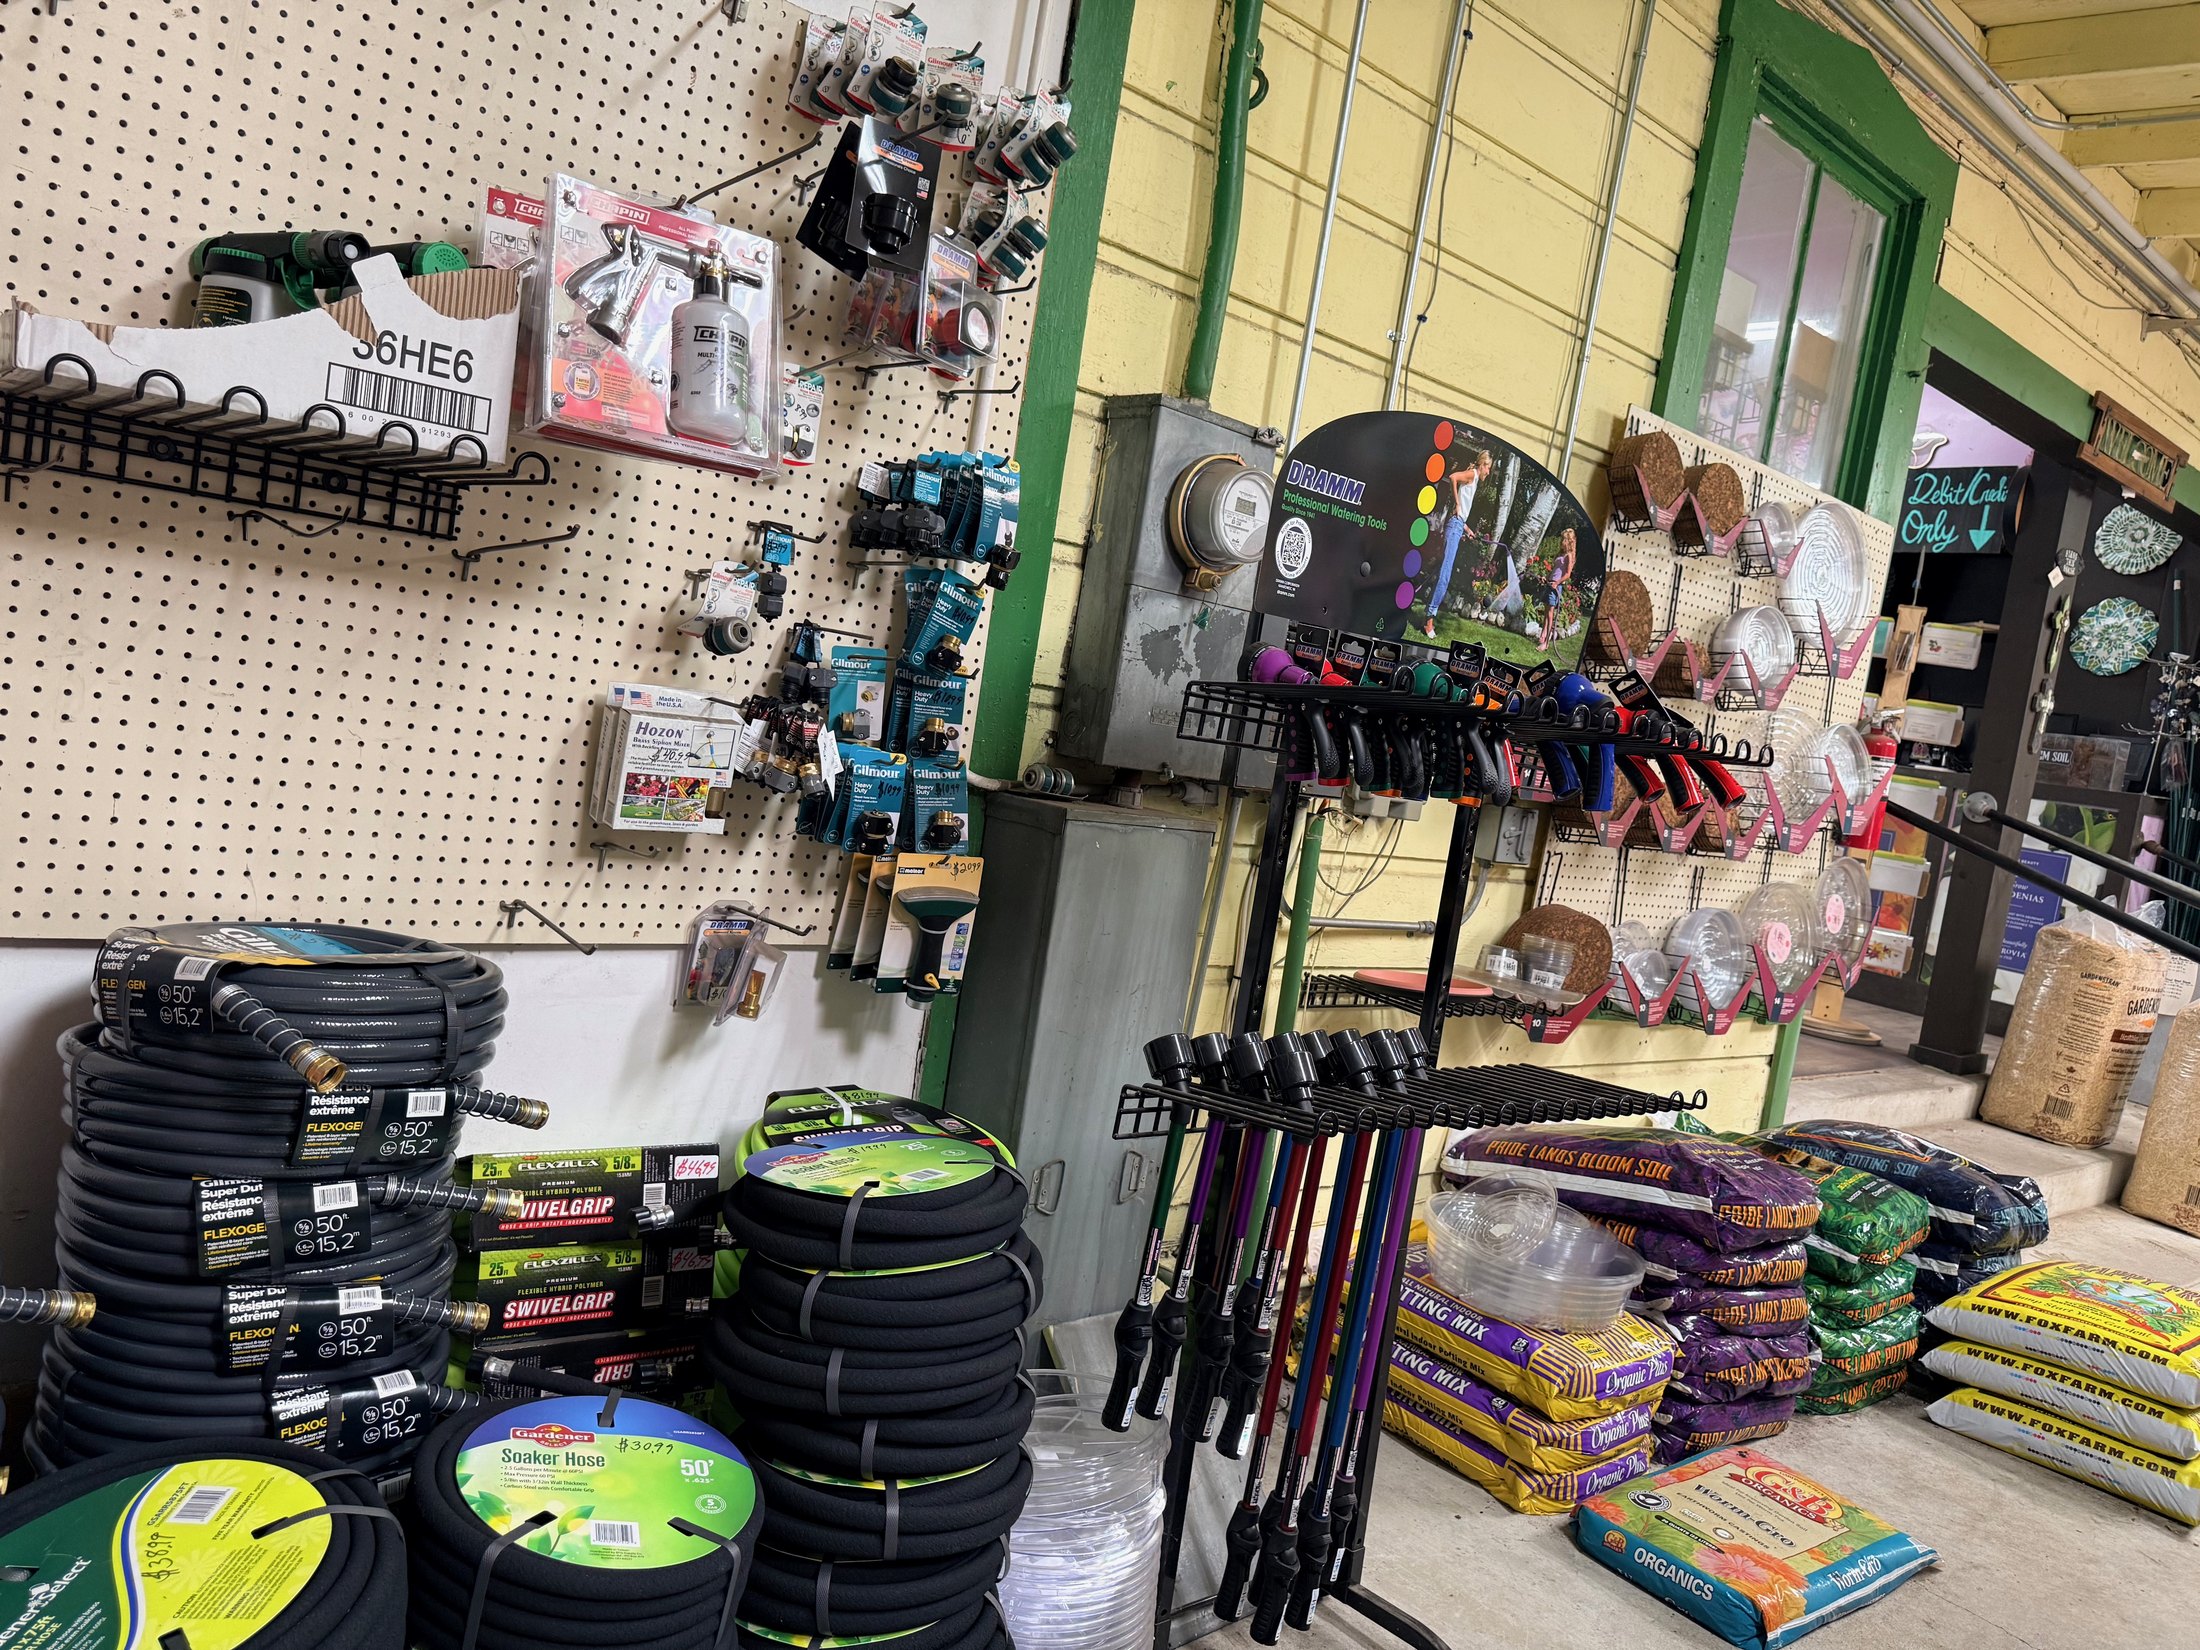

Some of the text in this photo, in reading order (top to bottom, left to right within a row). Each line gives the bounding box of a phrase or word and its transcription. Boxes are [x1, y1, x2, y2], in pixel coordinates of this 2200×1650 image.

[881, 138, 919, 161] DRAMM
[937, 243, 970, 269] DRAMM
[916, 471, 940, 483] Gilmour
[983, 466, 1016, 486] Gilmour
[1286, 459, 1366, 506] DRAMM
[1908, 467, 2008, 505] Debit/Credi
[1283, 488, 1330, 514] Professional
[1331, 504, 1366, 527] Watering
[1367, 515, 1388, 531] Tools
[1901, 508, 1959, 553] Only
[937, 597, 953, 610] Heavy
[940, 581, 979, 610] Gilmour
[935, 602, 950, 613] Duty
[1296, 644, 1323, 656] DRAMM
[1335, 651, 1364, 665] DRAMM
[831, 658, 871, 669] Gilmour
[1370, 658, 1397, 670] DRAMM
[1450, 659, 1479, 673] DRAMM
[912, 674, 962, 689] Gilmour
[1485, 675, 1513, 694] DRAMM
[914, 690, 933, 698] Heavy
[914, 695, 929, 703] Duty
[1619, 683, 1646, 701] DRAMM
[635, 721, 684, 739] HOZON
[633, 736, 691, 748] Brass Siphon Mixer
[2051, 751, 2070, 763] SOIL
[853, 764, 900, 779] Gilmour
[913, 768, 961, 779] Gilmour
[853, 787, 867, 795] Duty
[854, 782, 873, 790] Heavy
[709, 920, 749, 930] DRAMM
[111, 940, 139, 951] Super
[311, 1095, 370, 1106] Résistance
[309, 1106, 355, 1116] extrême
[517, 1158, 601, 1173] FLEXZILLA
[782, 1156, 860, 1175] Soaker Hose
[1485, 1140, 1674, 1182] PRIDE LANDS BLOOM SOIL
[1841, 1152, 1890, 1172] POTTING
[1893, 1157, 1922, 1178] SOIL
[201, 1187, 239, 1198] Super
[543, 1185, 603, 1196] HYBRID POLYMER
[202, 1196, 263, 1212] Résistanc
[521, 1197, 615, 1219] WIVELGRIP
[202, 1207, 254, 1222] extrême
[541, 1219, 563, 1228] ROTATE
[564, 1216, 613, 1226] INDEPENDENTLY
[1717, 1204, 1763, 1229] PRIDE
[1765, 1204, 1793, 1230] LANDS
[204, 1222, 267, 1240] FLEXOGE
[1606, 1220, 1639, 1247] SOIL
[523, 1255, 602, 1270] FLEXZILLA
[1773, 1258, 1807, 1283] BLOOM
[517, 1281, 604, 1296] FLEXIBLE HYBRID POLYMER
[545, 1276, 578, 1284] PREMIUM
[228, 1289, 265, 1301] Super
[1414, 1283, 1484, 1323] NATURAL INDOOR
[2011, 1293, 2073, 1314] Jump Start
[503, 1291, 615, 1320] SWIVELGRIP
[1749, 1301, 1779, 1324] LANDS
[1780, 1297, 1809, 1322] BLOOM
[229, 1309, 280, 1324] extrême
[1450, 1311, 1491, 1342] MIX
[1516, 1336, 1528, 1348] 25
[1970, 1303, 2169, 1367] WWW.FOXFARM.COM
[1409, 1329, 1487, 1377] Indoor Potting Mix
[1854, 1351, 1882, 1374] LANDS
[1431, 1365, 1472, 1397] MIX
[1605, 1352, 1671, 1397] Organic Plus
[1966, 1347, 2165, 1420] WWW.FOXFARM.COM
[276, 1389, 330, 1409] Résistanc
[1390, 1380, 1464, 1427] Indoor Potting Mix
[279, 1402, 325, 1421] extrême
[514, 1429, 591, 1443] Gardener
[1590, 1407, 1651, 1450] Organic Plus
[614, 1437, 675, 1455] $30.99
[1972, 1399, 2178, 1481] WWW.FOXFARM.COM
[501, 1448, 606, 1468] Soaker Hose
[1585, 1453, 1648, 1497] Organic Plus
[1741, 1477, 1818, 1520] ORGANICS
[1753, 1470, 1831, 1516] G&B
[231, 1492, 255, 1521] WARRANTY
[1693, 1483, 1797, 1549] Worm-Gro
[1676, 1491, 1728, 1523] EARTHWORM
[1727, 1520, 1771, 1549] CASTINGS
[38, 1559, 93, 1608] Select
[1633, 1547, 1714, 1601] ORGANICS
[172, 1593, 198, 1620] CAUTION
[224, 1591, 250, 1620] WARNING
[24, 1615, 56, 1637] 75ft
[32, 1622, 62, 1645] HOSE
